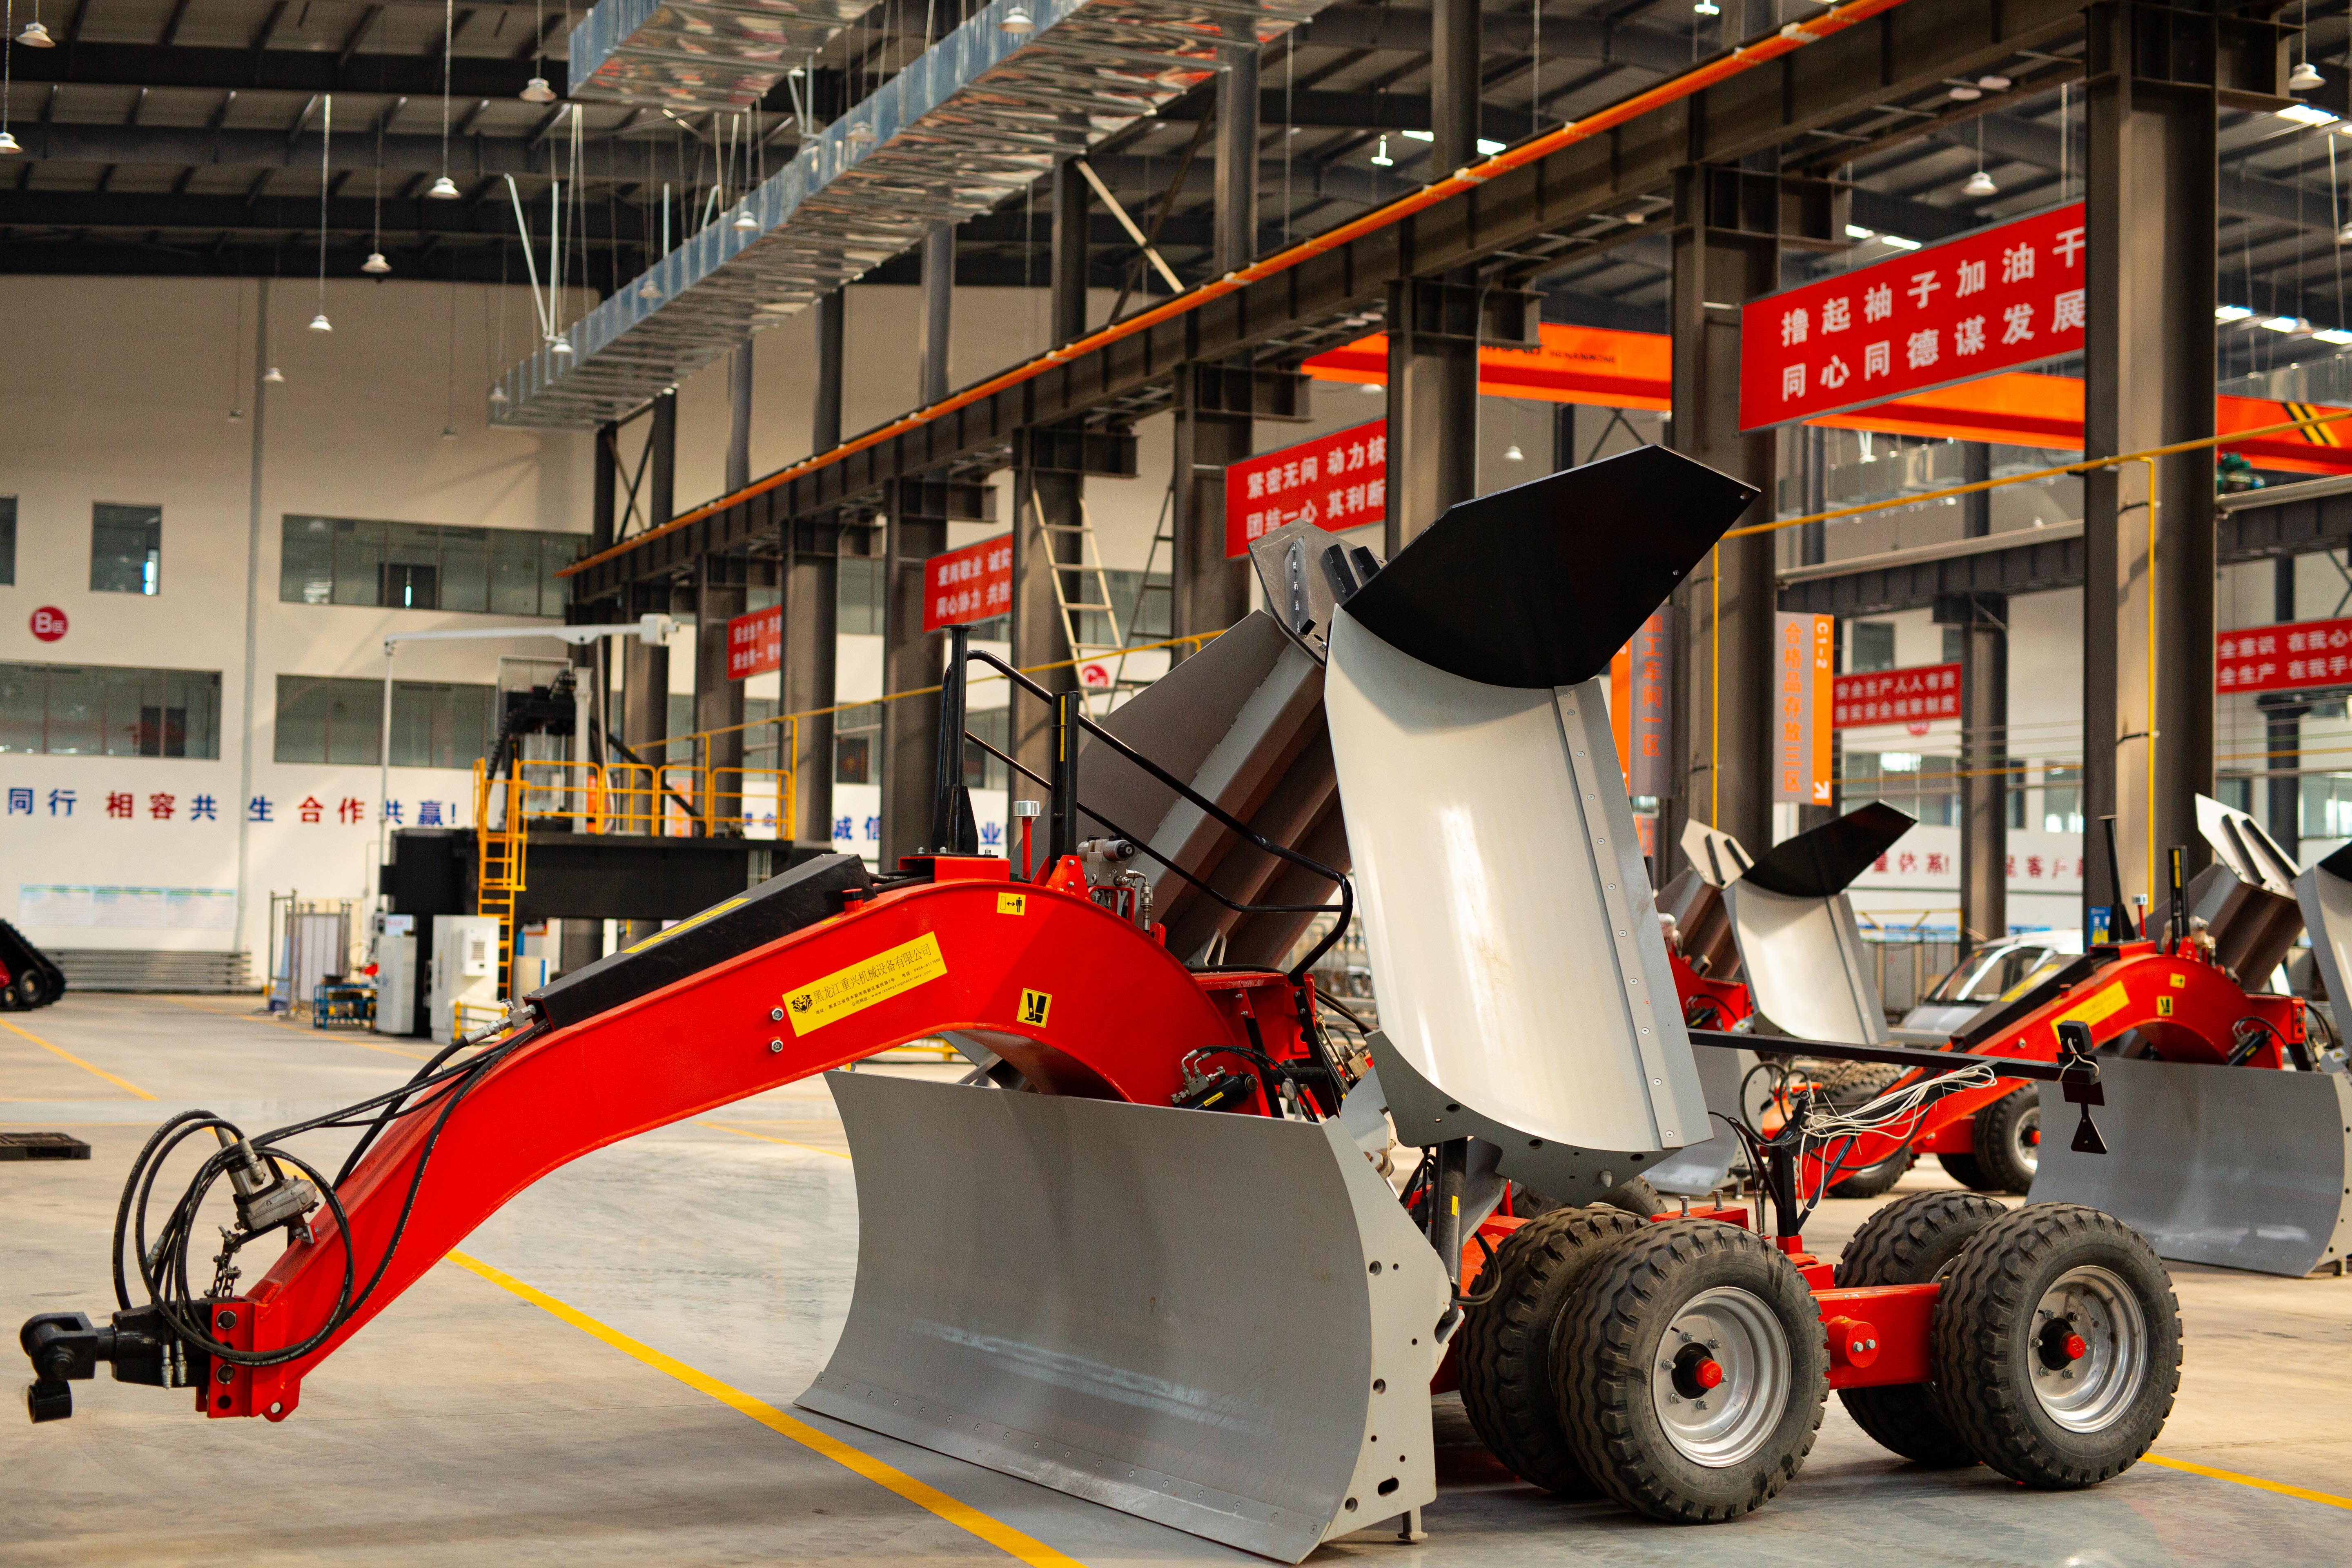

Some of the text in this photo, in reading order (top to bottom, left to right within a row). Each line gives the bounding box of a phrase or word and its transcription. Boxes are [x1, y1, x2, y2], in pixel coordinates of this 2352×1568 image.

[1782, 289, 2085, 402] 同心同德谋发展
[1327, 479, 1385, 519] 其利断
[2287, 628, 2352, 652] 在我心
[2287, 656, 2352, 680] 在我手
[1783, 621, 1803, 792] 合格品存放三区
[8, 787, 77, 816] 同行
[811, 943, 932, 1004] 黑龙江重兴机械设备有限公司
